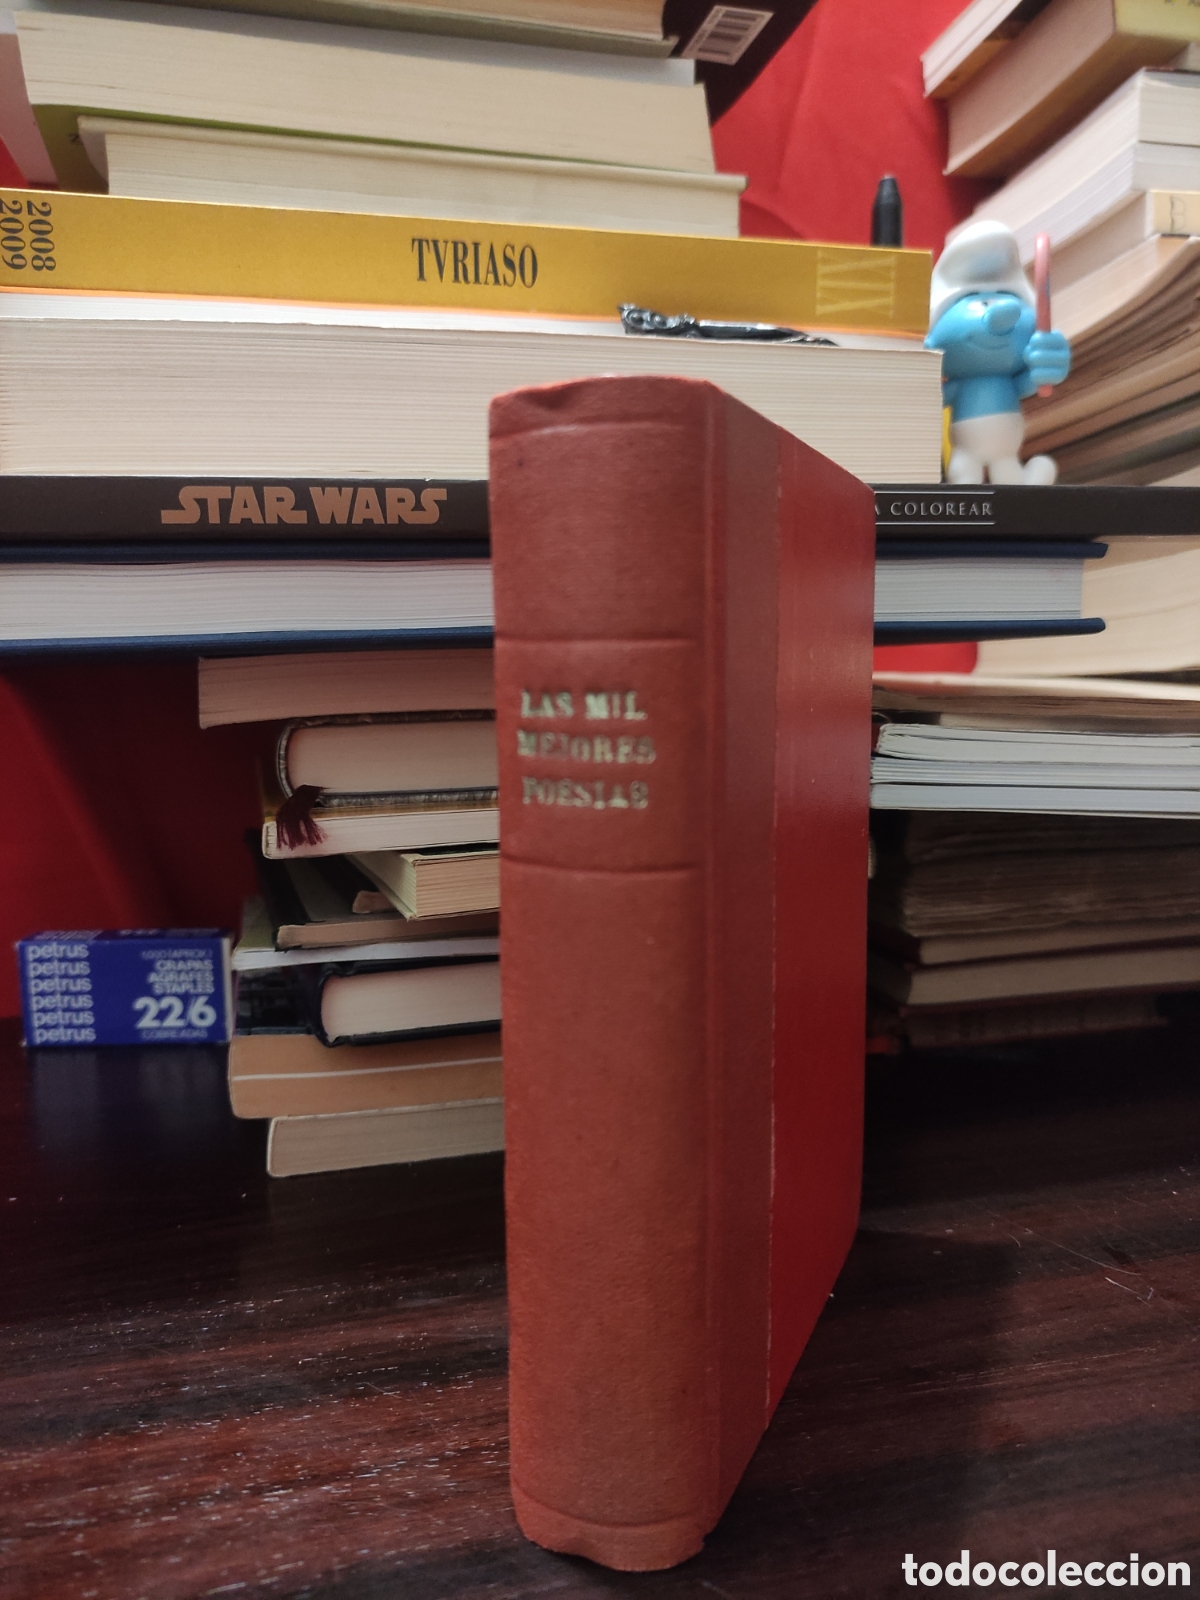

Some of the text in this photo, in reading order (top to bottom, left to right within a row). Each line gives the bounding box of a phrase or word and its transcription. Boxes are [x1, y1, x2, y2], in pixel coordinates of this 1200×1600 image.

[0, 198, 27, 270] 2009
[27, 200, 56, 271] 2008
[411, 238, 538, 289] TVRIASO
[161, 486, 447, 524] STAR WARS
[890, 502, 992, 516] COLOREAR
[521, 689, 648, 721] LAS MIL
[517, 730, 657, 765] MEJORES
[28, 942, 89, 961] petrus
[29, 960, 91, 978] petrus
[30, 976, 92, 995] petrus
[153, 982, 215, 995] STAPLES
[32, 992, 93, 1012] petrus
[133, 995, 217, 1029] 22/6
[33, 1010, 95, 1028] petrus
[34, 1026, 96, 1044] petrus
